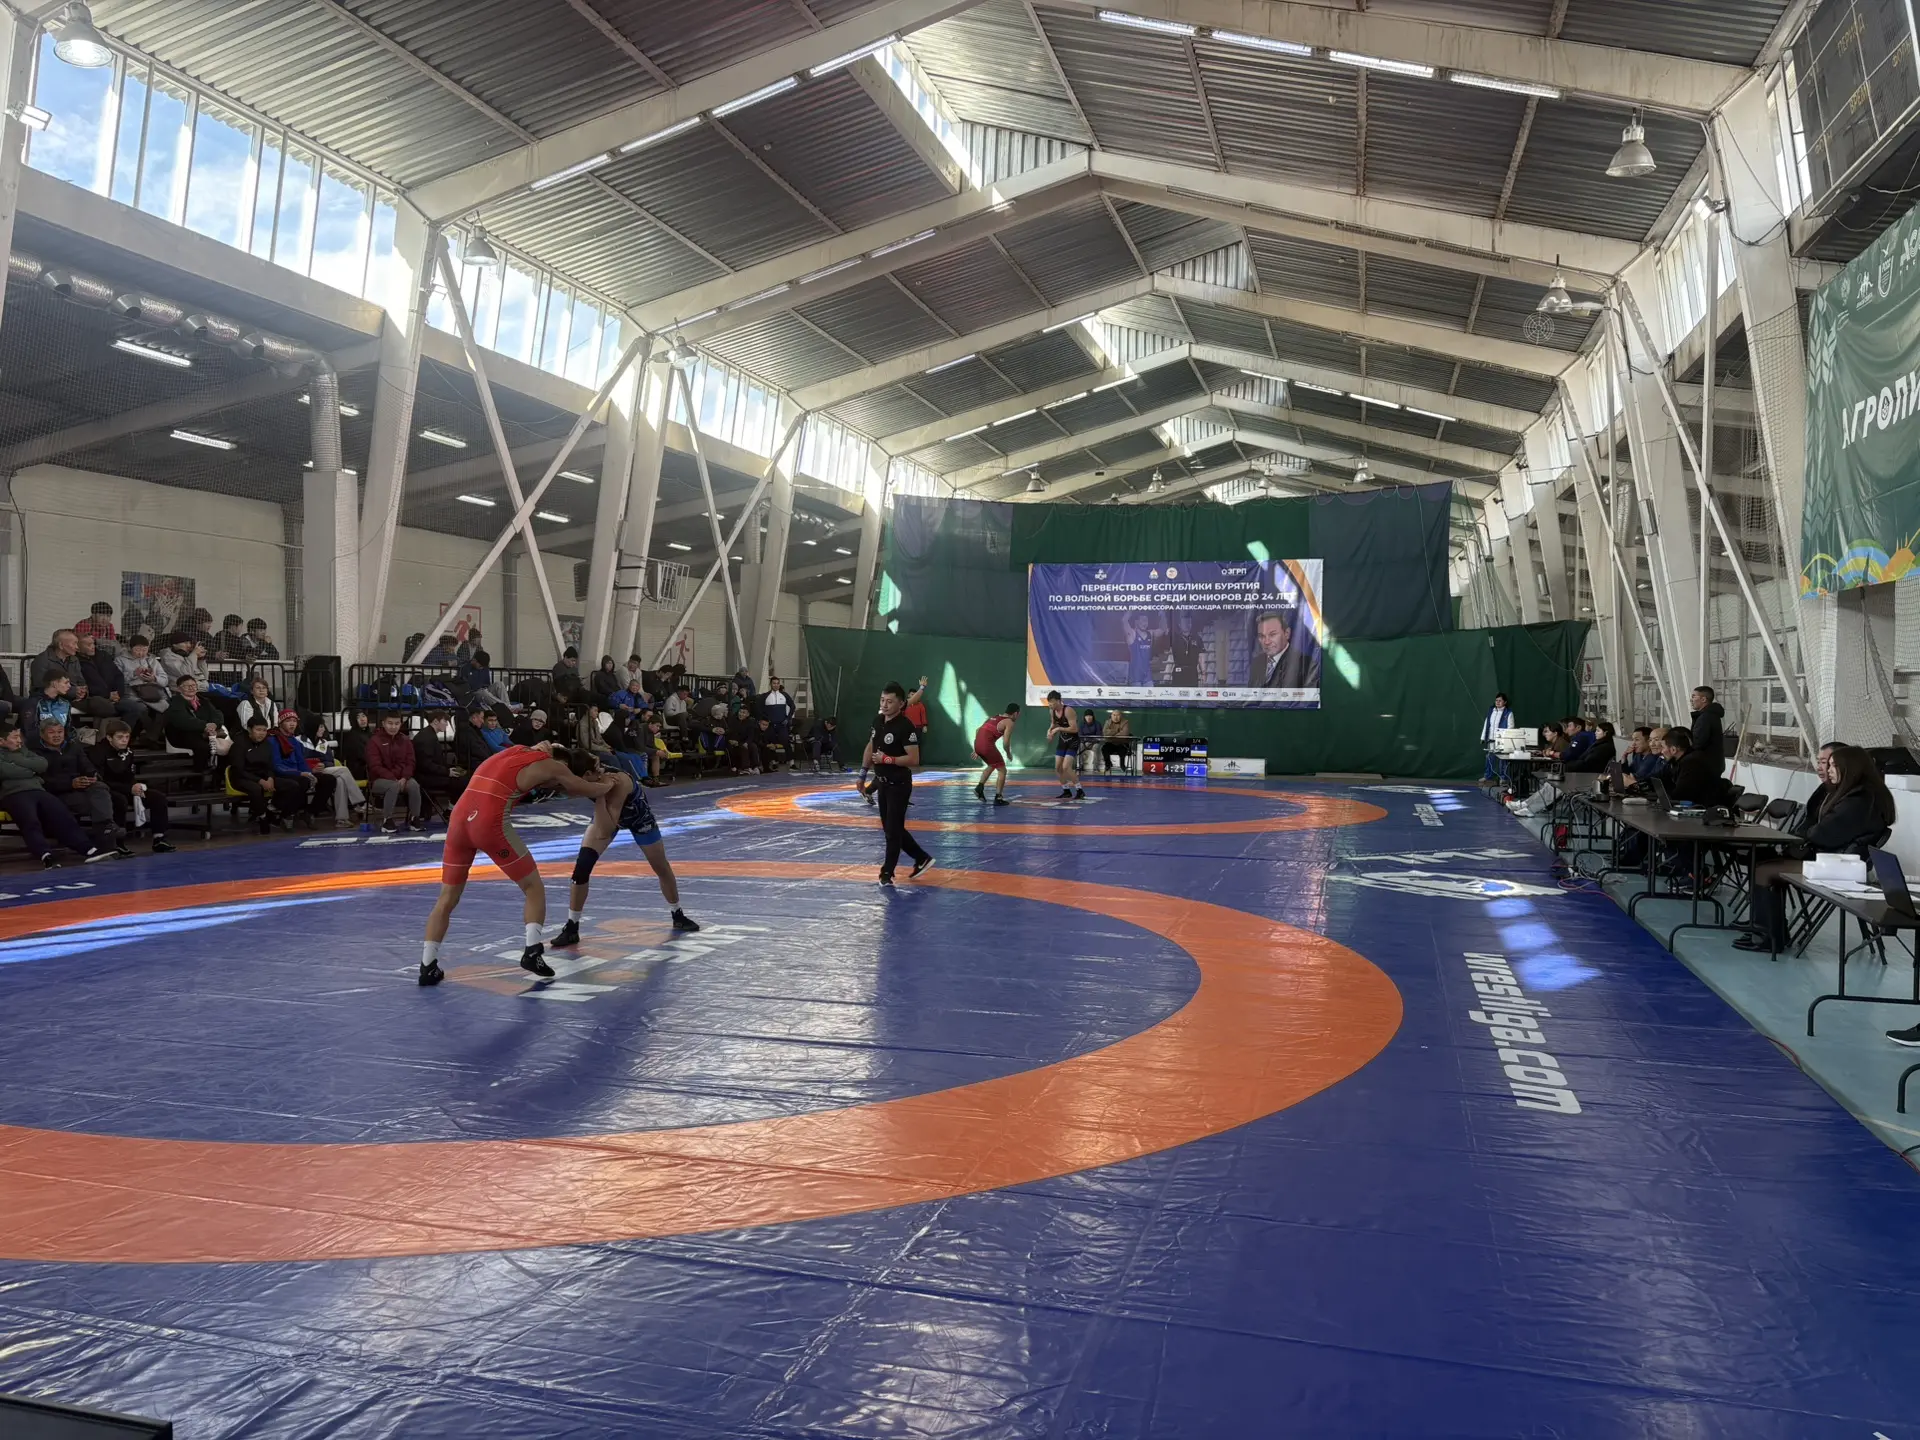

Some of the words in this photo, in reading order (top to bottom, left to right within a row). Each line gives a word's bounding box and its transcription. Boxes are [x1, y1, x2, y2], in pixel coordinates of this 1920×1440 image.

[1081, 583, 1144, 592] ПЕРВЕНСТВО
[1147, 583, 1212, 592] РЕСПУБЛИКИ
[1215, 582, 1260, 591] БУРЯТИЯ
[1049, 594, 1063, 602] ПО
[1065, 593, 1111, 602] ВОЛЬНОЙ
[1114, 594, 1151, 602] БОРЬБЕ
[1154, 594, 1187, 603] СРЕДИ
[1189, 593, 1242, 602] ЮНИОРОВ
[1244, 594, 1259, 602] ДО
[1150, 764, 1156, 773] 2
[1164, 764, 1185, 773] 4:23
[1193, 765, 1199, 774] 2
[1463, 952, 1582, 1114] wrestliga.com
